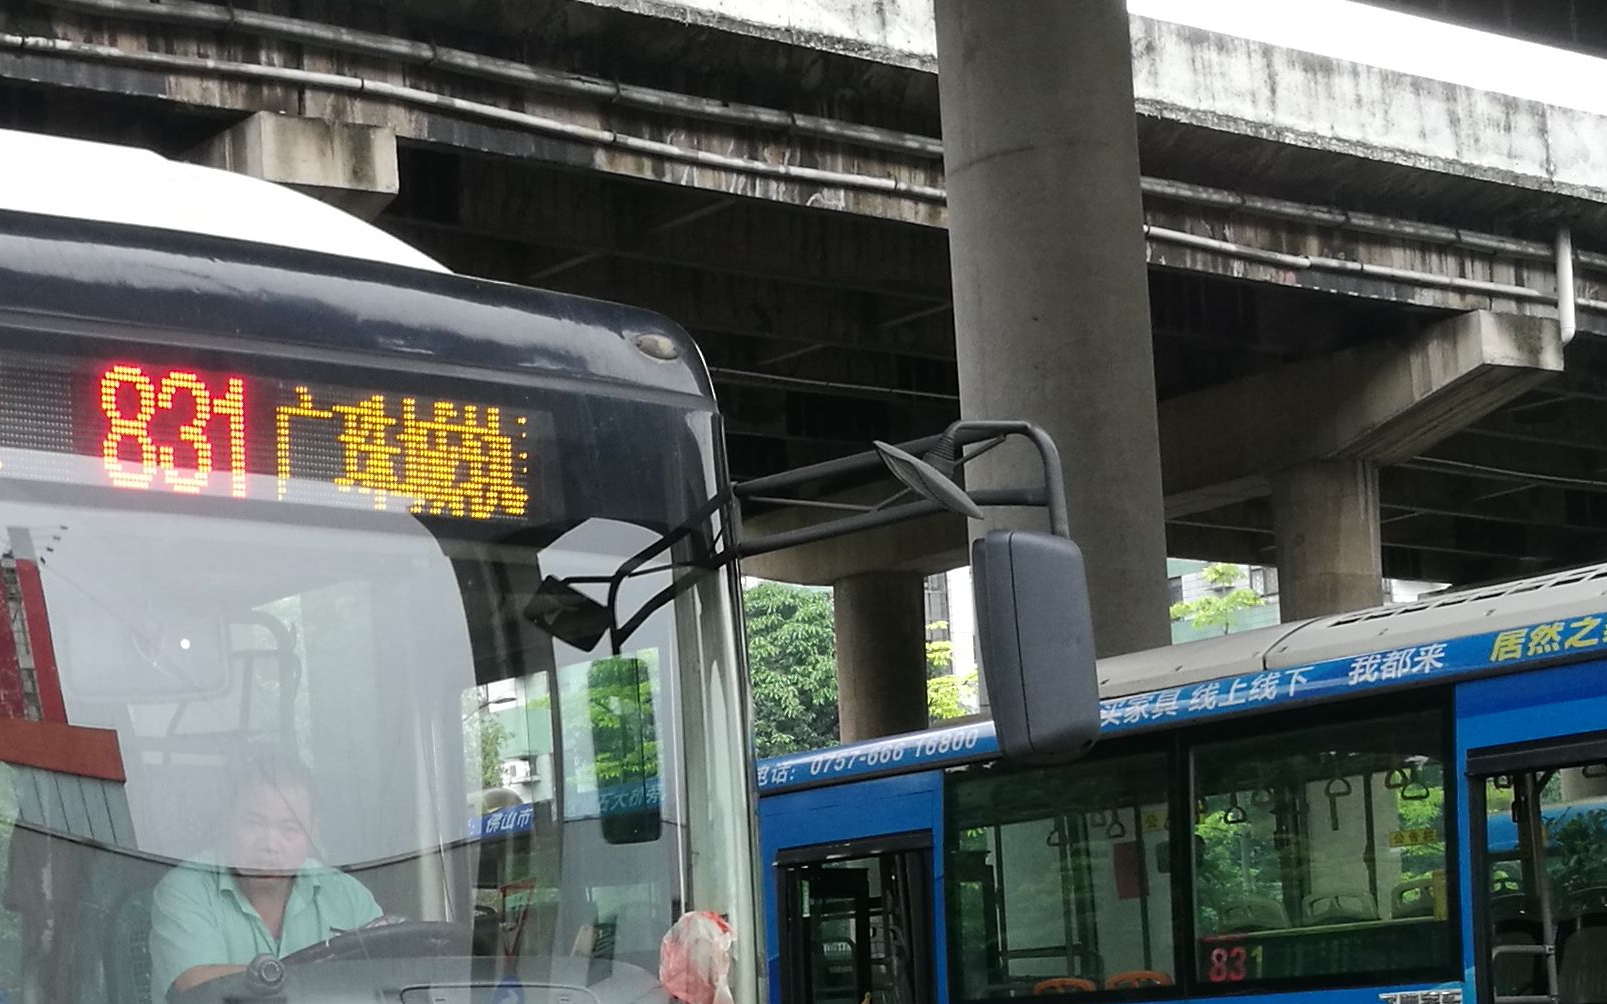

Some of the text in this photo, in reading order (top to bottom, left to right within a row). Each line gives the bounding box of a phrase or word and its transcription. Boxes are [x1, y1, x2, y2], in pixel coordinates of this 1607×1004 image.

[99, 364, 246, 499] 831
[1189, 666, 1314, 711] 线上线下
[1348, 643, 1447, 686] 我都来
[1490, 614, 1607, 662] 居然之
[486, 808, 533, 833] 佛山市
[1208, 946, 1263, 983] 831
